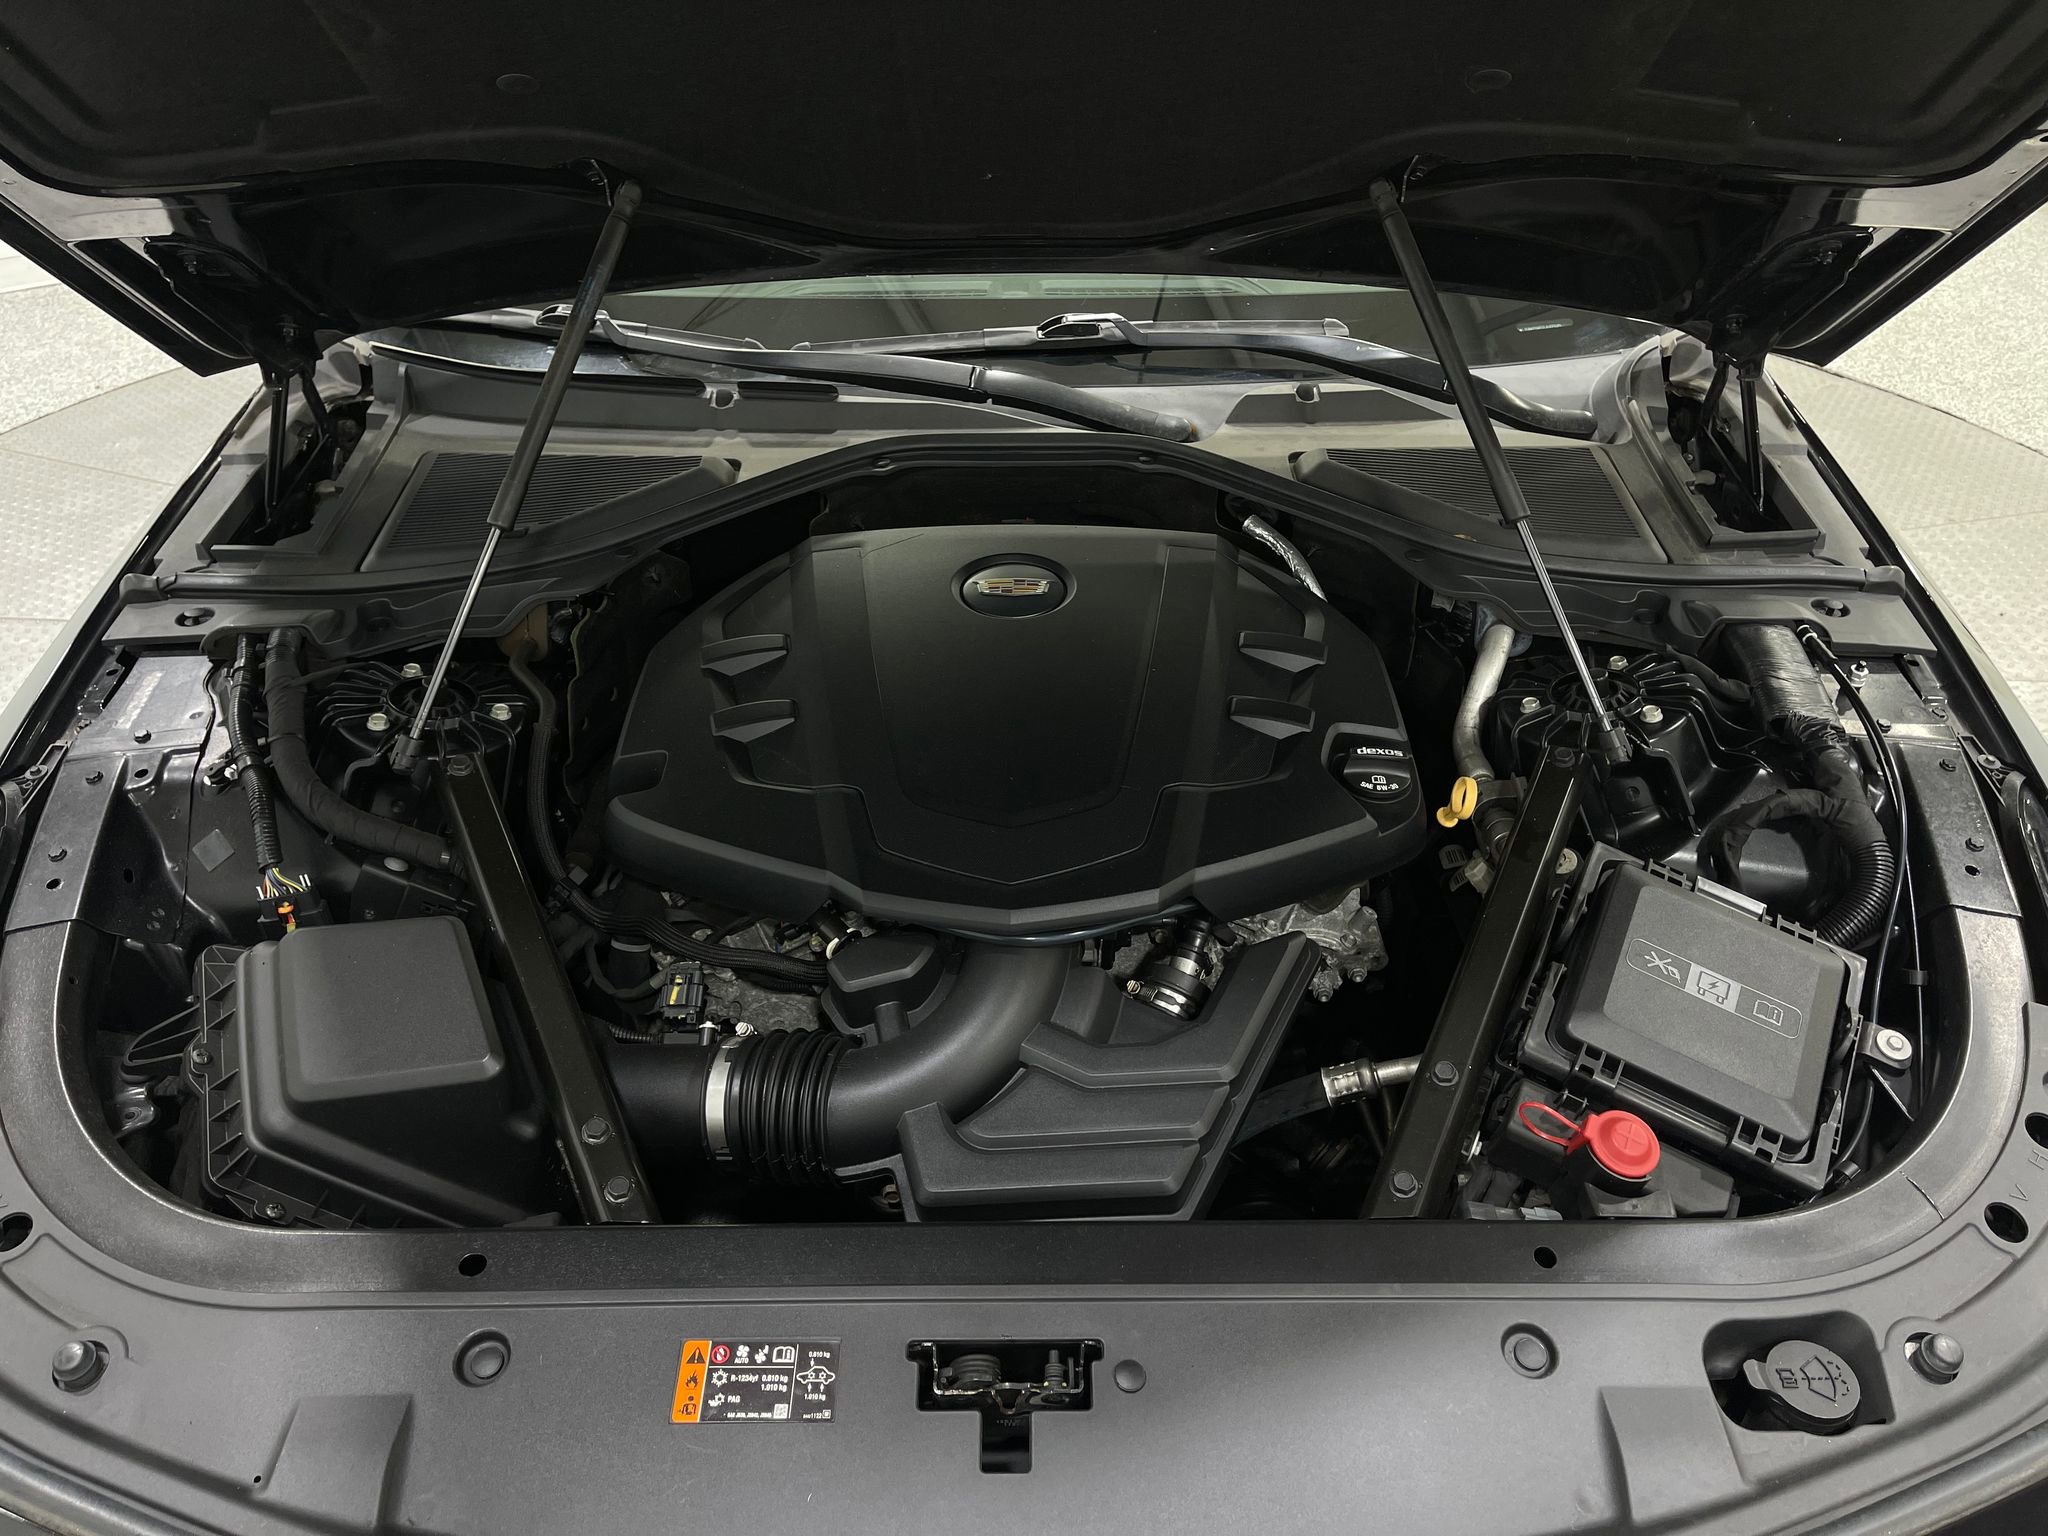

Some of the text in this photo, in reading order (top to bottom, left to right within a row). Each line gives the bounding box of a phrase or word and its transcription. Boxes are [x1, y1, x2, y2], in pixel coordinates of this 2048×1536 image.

[1356, 746, 1404, 757] dexos
[1360, 781, 1374, 790] SAE
[2028, 1149, 2048, 1170] H
[727, 1395, 741, 1403] PAG
